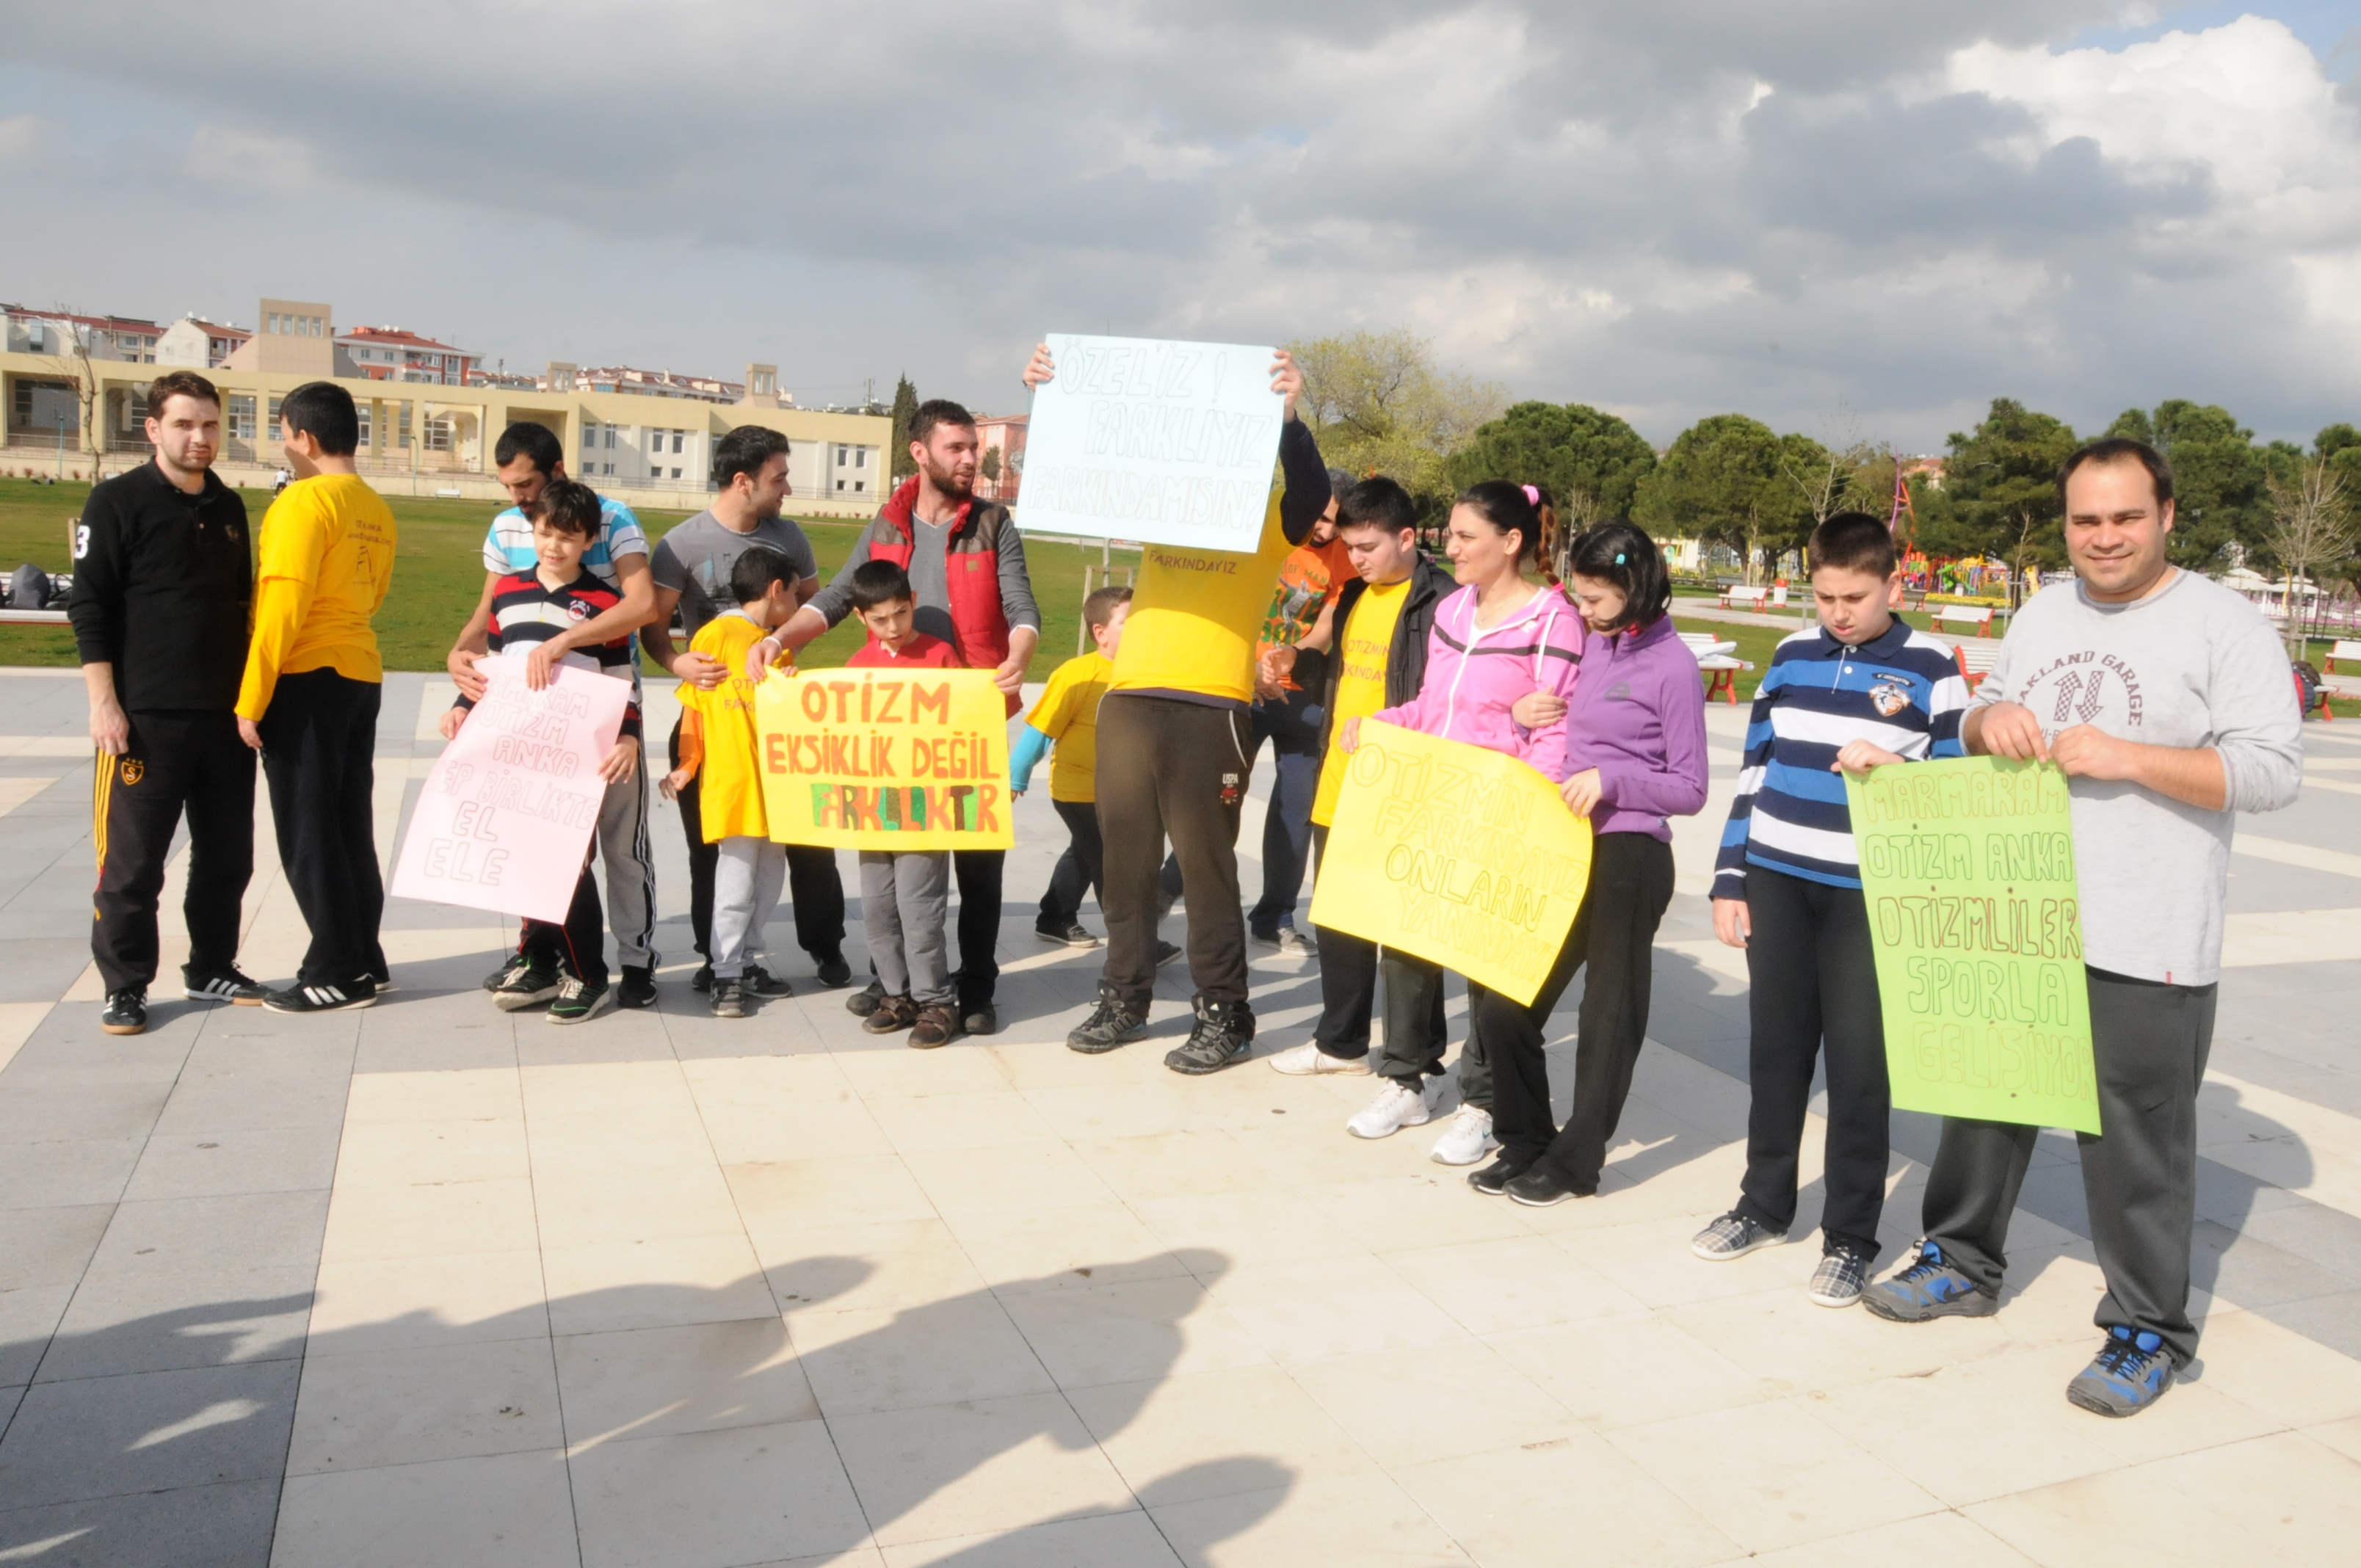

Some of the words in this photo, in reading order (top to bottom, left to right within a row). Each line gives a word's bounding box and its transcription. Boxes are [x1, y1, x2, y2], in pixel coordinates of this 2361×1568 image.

[1084, 400, 1273, 468] FARKLIYIZ
[1028, 465, 1268, 532] FARKINDAMISIN?
[1148, 550, 1237, 575] FARKINDAYIZ
[801, 671, 951, 725] OTİZM
[2017, 650, 2095, 708] AKLAND
[2100, 653, 2143, 726] GARAGE
[479, 700, 570, 744] OTİZM
[493, 736, 579, 780] ANKA
[766, 727, 897, 777] EKSİKLİK
[911, 731, 1001, 779] DEĞİL
[451, 800, 498, 842] EL
[476, 769, 600, 830] BİRLİKTE
[1862, 769, 2066, 822] MARMARAM
[424, 838, 510, 887] ELE
[1374, 796, 1589, 901] FARKINDAYIZ
[1865, 823, 1972, 880] OTİZM
[1986, 832, 2072, 881] ANKA
[1385, 843, 1547, 932] ONLARIN
[1878, 885, 2081, 959] OTİZMLİLER
[1907, 956, 2069, 1026] SPORLA
[1912, 1020, 2097, 1106] GELİŞİYOR
